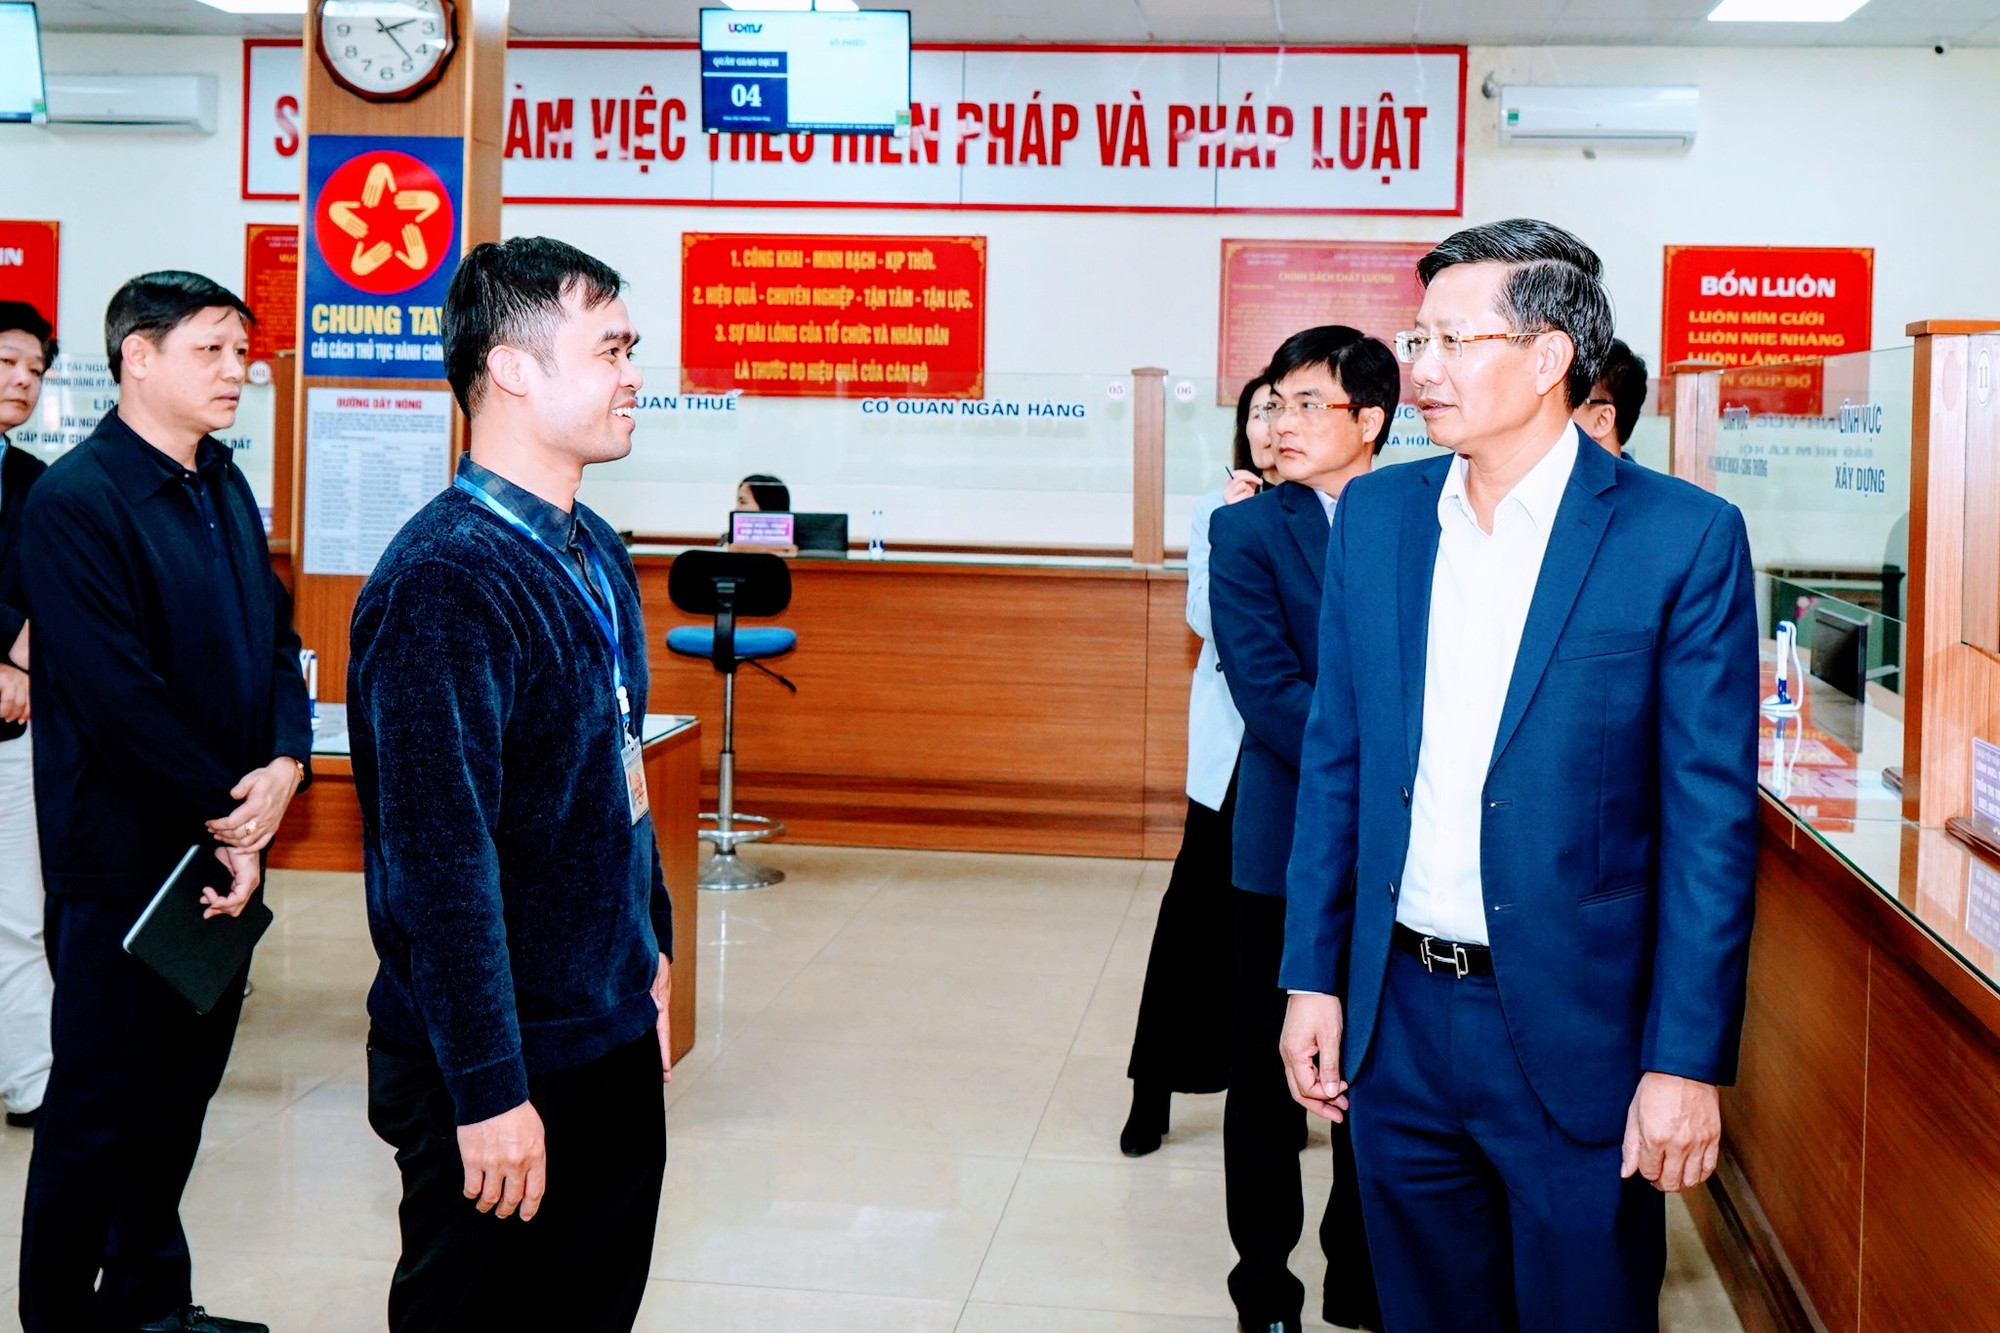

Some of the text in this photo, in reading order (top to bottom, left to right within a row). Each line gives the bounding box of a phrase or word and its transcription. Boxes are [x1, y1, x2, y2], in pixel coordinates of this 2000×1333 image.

[336, 23, 351, 37] 9
[421, 20, 435, 34] 3
[344, 45, 358, 58] 8
[414, 43, 428, 55] 4
[361, 59, 372, 71] 7
[401, 59, 413, 72] 5
[380, 66, 394, 80] 6
[731, 83, 762, 107] 04
[504, 83, 573, 160] ÀM
[591, 85, 686, 173] VIỆC
[957, 91, 1079, 166] PHÁP
[1096, 91, 1150, 167] VÀ
[1168, 92, 1295, 169] PHÁP
[1311, 92, 1428, 185] LUẬT
[0, 248, 24, 267] IN
[743, 246, 775, 268] CÔNG
[776, 250, 803, 268] KHAI
[1701, 268, 1836, 298] BỐN LUÔN
[311, 303, 402, 335] CHUNG
[1688, 310, 1739, 324] LUÔN
[1688, 330, 1739, 344] LUÔN
[311, 337, 328, 358] CẢI
[329, 338, 355, 359] CÁCH
[356, 338, 374, 359] THỦ
[375, 342, 393, 363] TỤC
[394, 340, 421, 360] HÀNH
[1108, 385, 1124, 394] 05
[1177, 386, 1191, 395] 06
[635, 396, 677, 409] UAN
[862, 399, 1086, 417] CƠ QUAN NGÂN HÀNG
[1835, 462, 1885, 498] XÂY DỰNG
